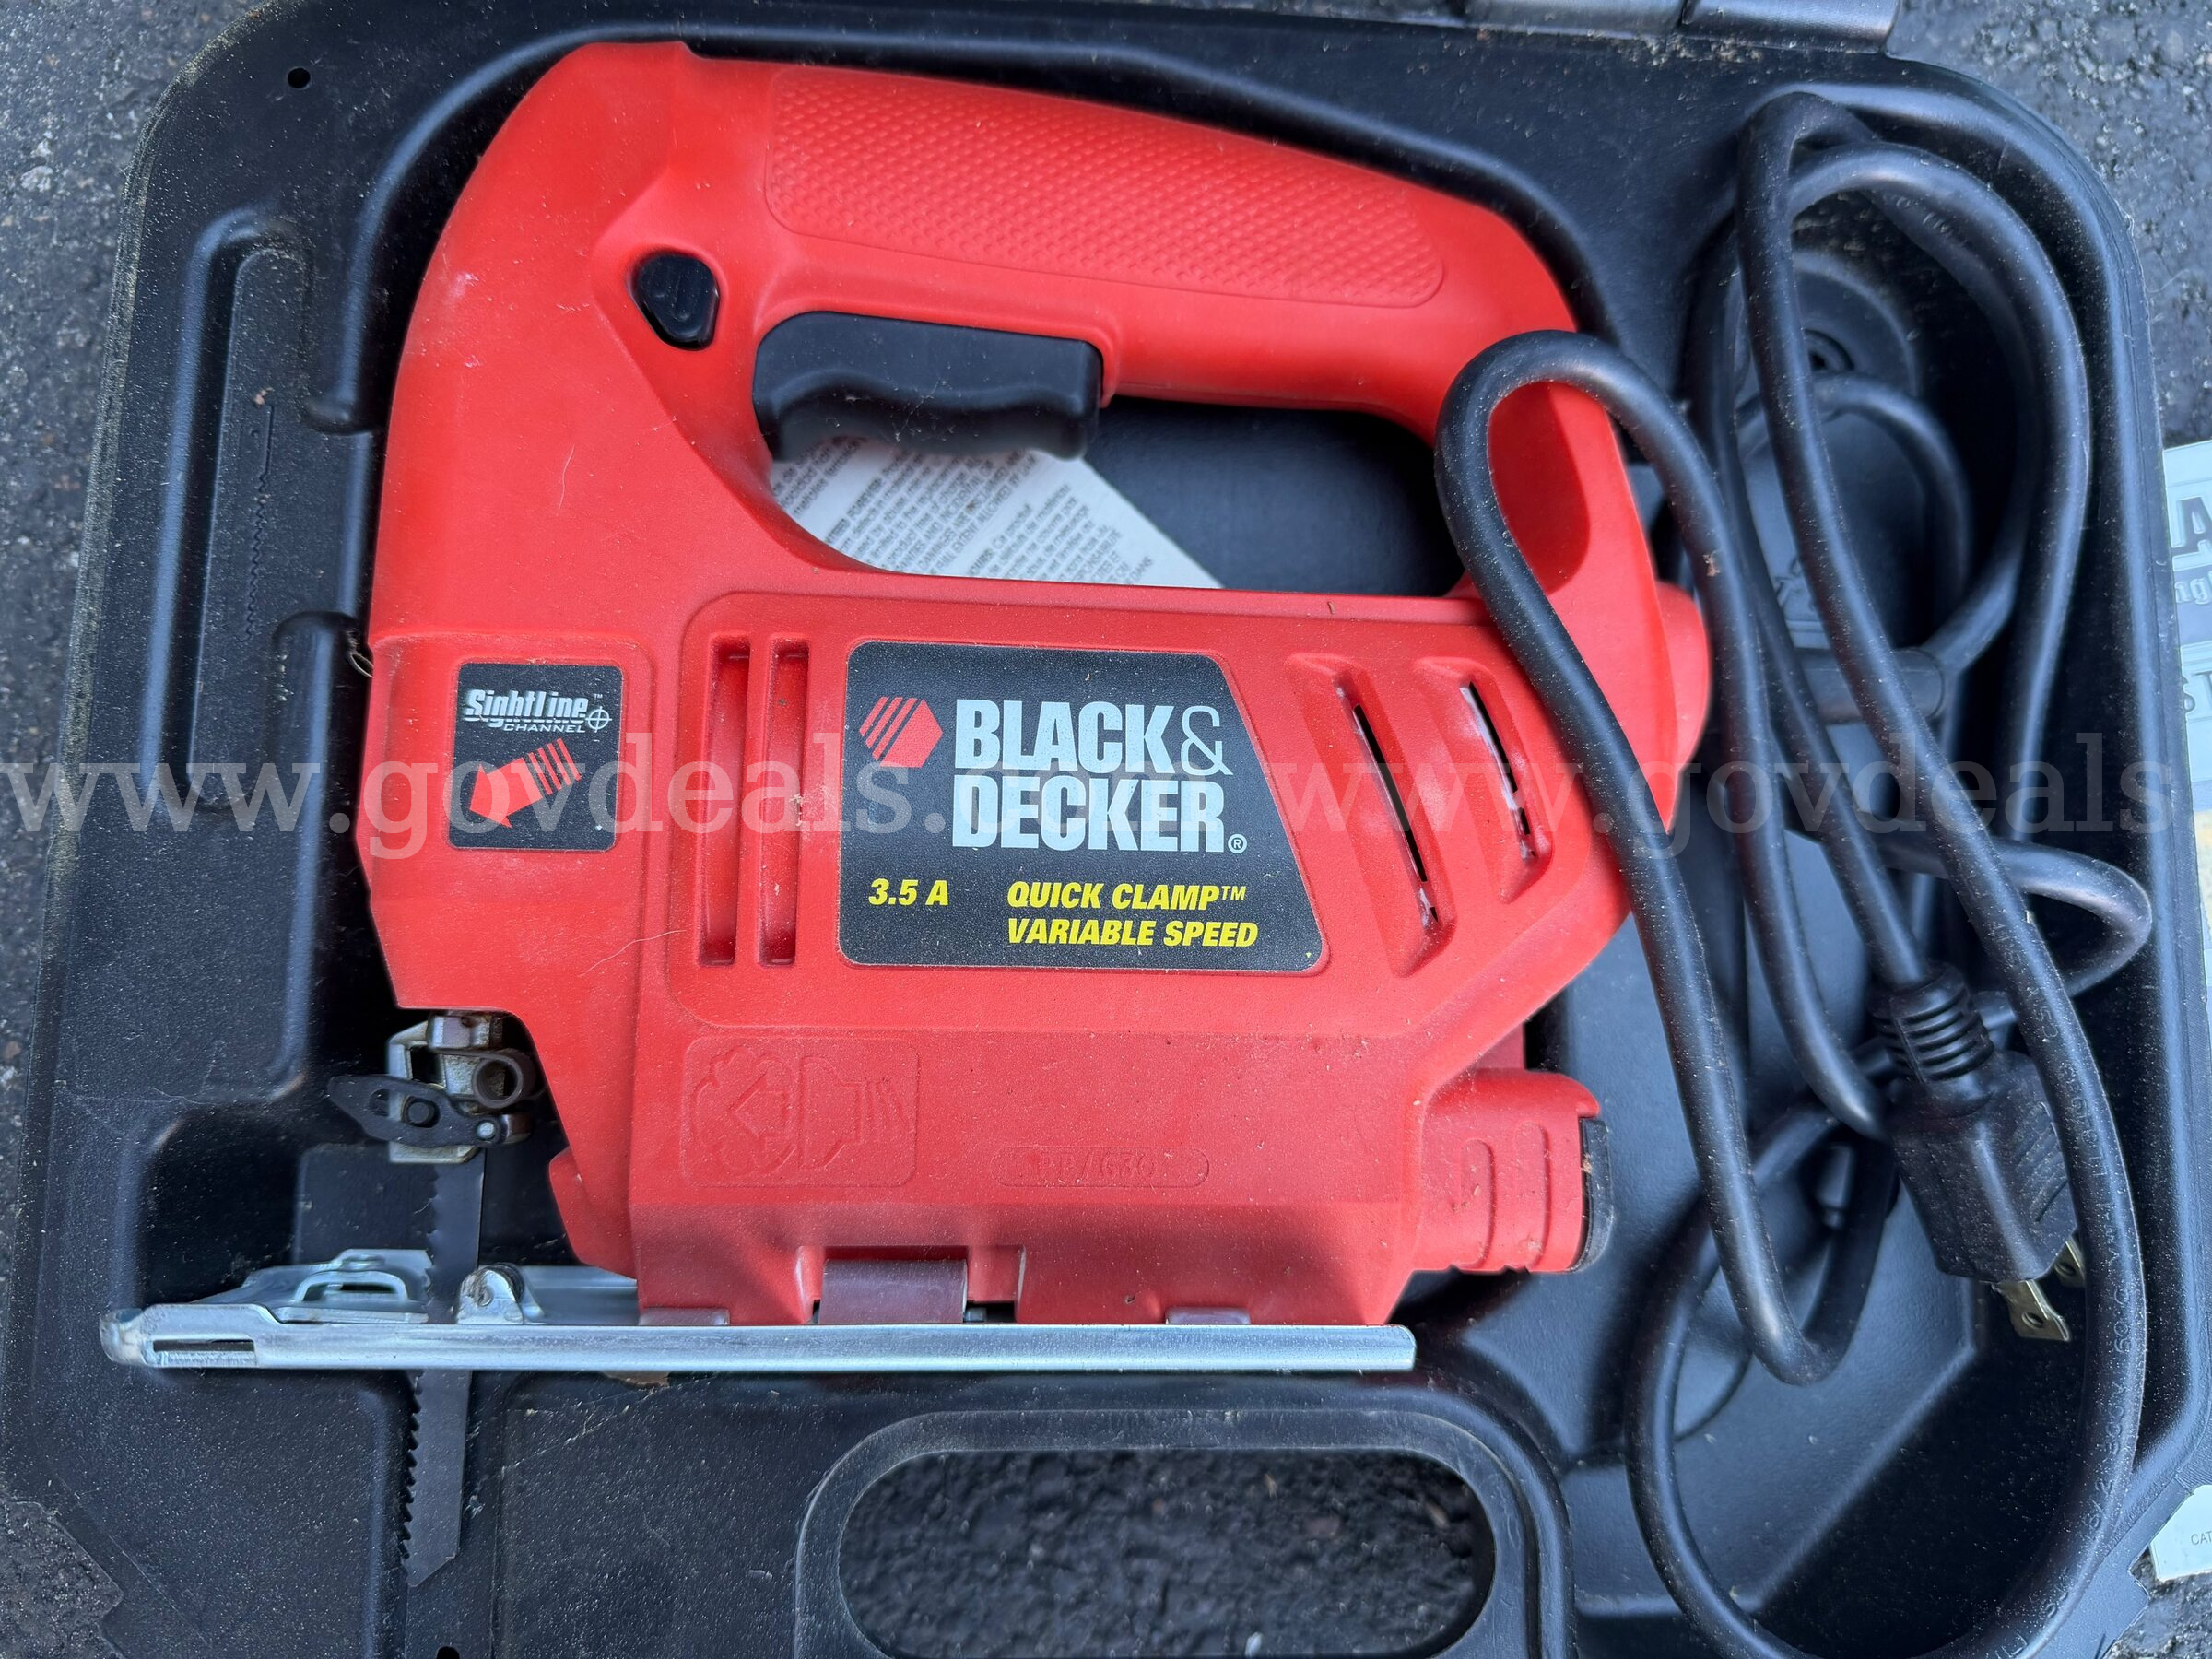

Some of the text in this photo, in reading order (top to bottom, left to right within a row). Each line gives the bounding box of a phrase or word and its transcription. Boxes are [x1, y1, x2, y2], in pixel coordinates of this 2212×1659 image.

[503, 724, 585, 735] CHANNEL
[868, 877, 948, 907] 3.5 A
[1007, 881, 1105, 911] QUICK
[1007, 918, 1259, 948] VARIABLE SPEED
